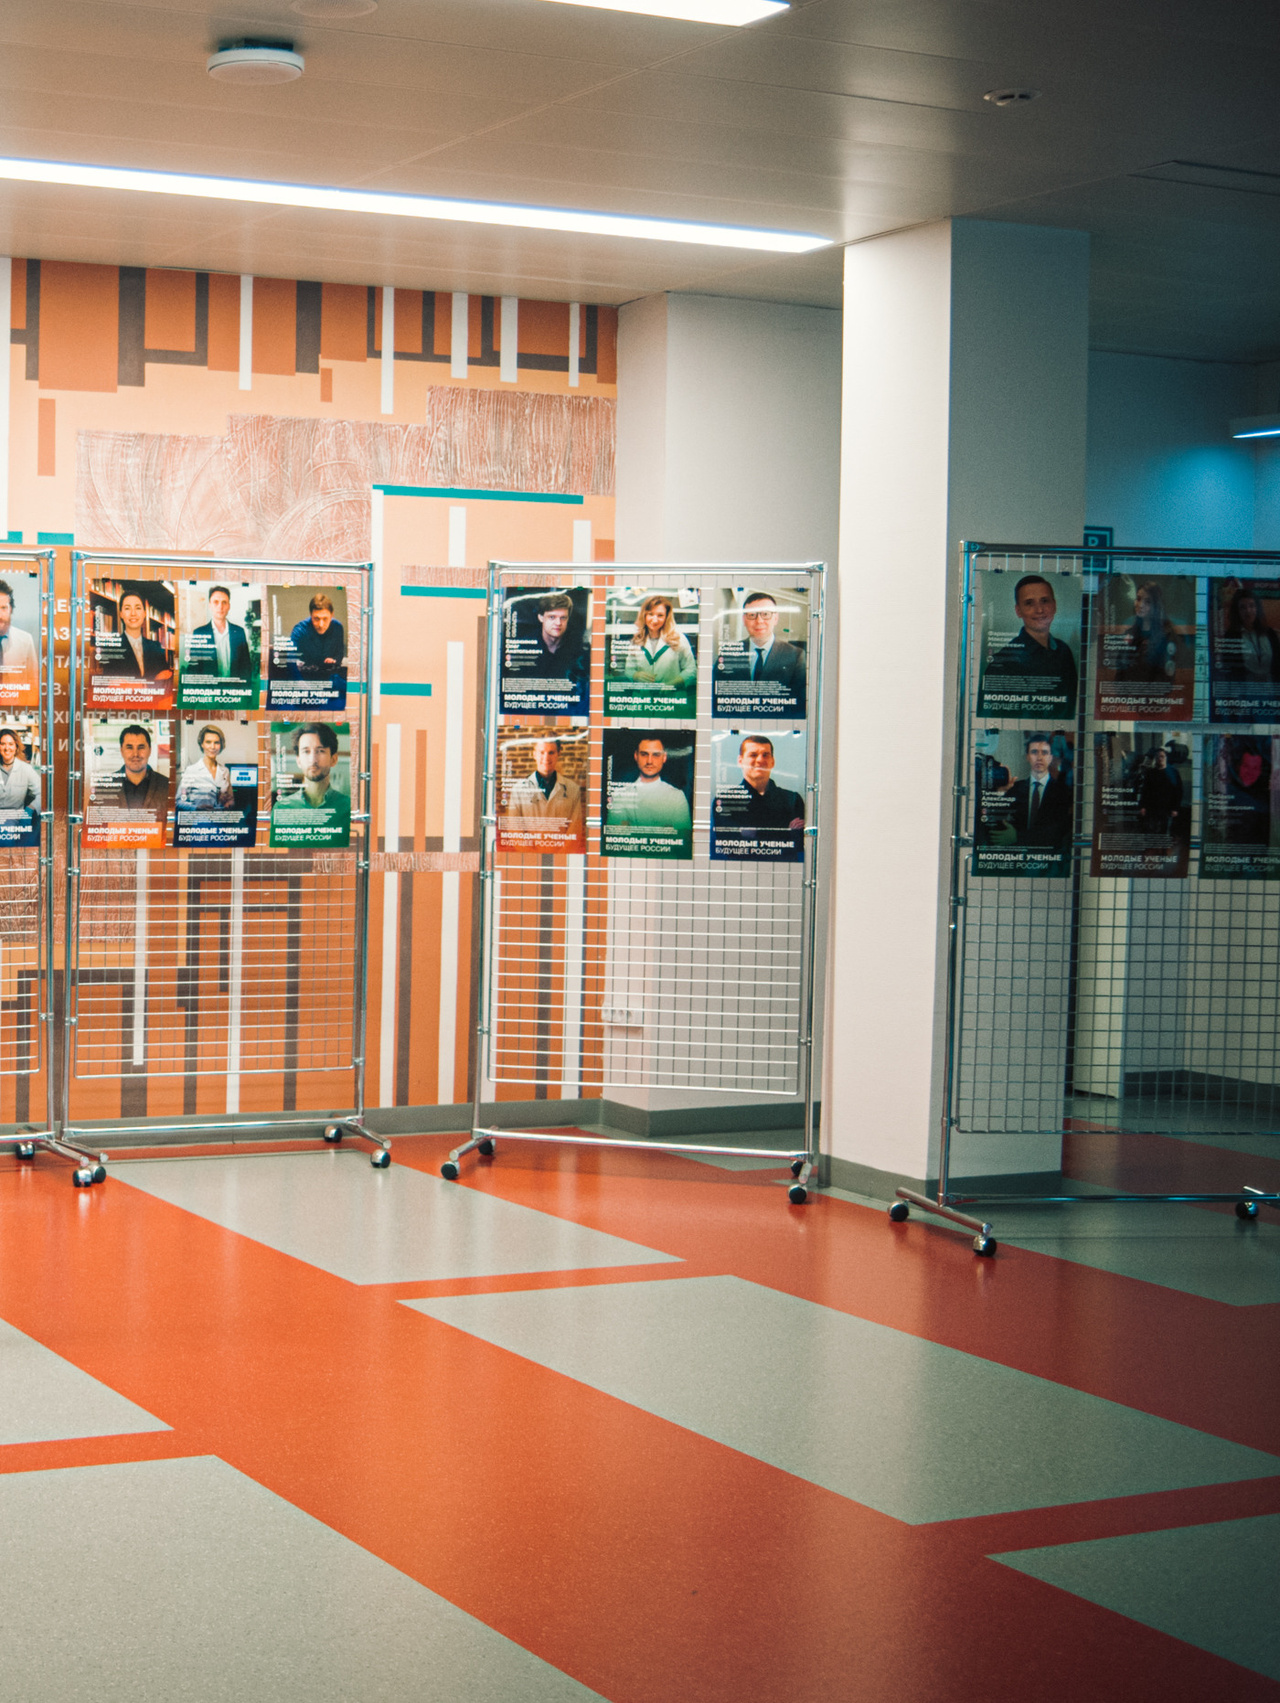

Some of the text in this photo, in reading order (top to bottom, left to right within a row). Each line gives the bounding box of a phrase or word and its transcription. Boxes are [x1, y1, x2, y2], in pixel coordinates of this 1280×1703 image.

[0, 683, 31, 691] УЧЕНЫЕ
[93, 687, 165, 696] МОЛОДЫЕ УЧЕНЫЕ
[183, 688, 252, 696] МОЛОДЫЕ УЧЕНЫЕ
[271, 690, 339, 698] МОЛОДЫЕ УЧЕНЫЕ
[93, 695, 153, 703] БУДУЩЕЕ РОССИИ
[183, 695, 241, 703] БУДУЩЕЕ РОССИИ
[271, 697, 328, 705] БУДУЩЕЕ РОССИИ
[504, 694, 580, 703] МОЛОДЫЕ УЧЕНЫЕ
[610, 696, 687, 705] МОЛОДЫЕ УЧЕНЫЕ
[717, 697, 797, 705] МОЛОДЫЕ УЧЕНЫЕ
[983, 694, 1067, 703] МОЛОДЫЕ УЧЕНЫЕ
[1101, 697, 1184, 705] МОЛОДЫЕ УЧЕНЫЕ
[504, 702, 568, 710] БУДУЩЕЕ РОССИИ
[983, 702, 1054, 711] БУДУЩЕЕ РОССИИ
[1215, 699, 1260, 708] МОЛОДЫЕ
[609, 704, 674, 712] БУДУЩЕЕ РОССИИ
[717, 705, 784, 713] БУДУЩЕЕ РОССИИ
[1101, 705, 1171, 713] БУДУЩЕЕ РОССИИ
[981, 795, 1016, 803] Александр
[1101, 799, 1140, 807] Андреевич
[0, 825, 33, 834] УЧЕНЫЕ
[87, 827, 159, 835] МОЛОДЫЕ УЧЕНЫЕ
[179, 827, 249, 835] МОЛОДЫЕ УЧЕНЫЕ
[275, 827, 343, 835] МОЛОДЫЕ УЧЕНЫЕ
[87, 834, 147, 842] БУДУЩЕЕ РОССИИ
[178, 834, 237, 842] БУДУЩЕЕ РОССИИ
[275, 834, 331, 842] БУДУЩЕЕ РОССИИ
[500, 832, 577, 841] МОЛОДЫЕ УЧЕНЫЕ
[500, 839, 565, 847] БУДУЩЕЕ РОССИИ
[606, 837, 684, 845] МОЛОДЫЕ УЧЕНЫЕ
[715, 840, 795, 848] МОЛОДЫЕ УЧЕНЫЕ
[605, 844, 639, 852] БУДУЩЕЕ
[715, 847, 781, 856] БУДУЩЕЕ РОССИИ
[978, 853, 1063, 861] МОЛОДЫЕ УЧЕНЫЕ
[1100, 854, 1178, 862] МОЛОДЫЕ УЧЕНЫЕ
[1205, 856, 1250, 864] МОЛОДЫЕ
[978, 861, 1049, 870] БУДУЩЕЕ РОССИИ
[1100, 862, 1164, 871] БУДУЩЕЕ РОССИИ
[1242, 864, 1275, 872] РОССИИ
